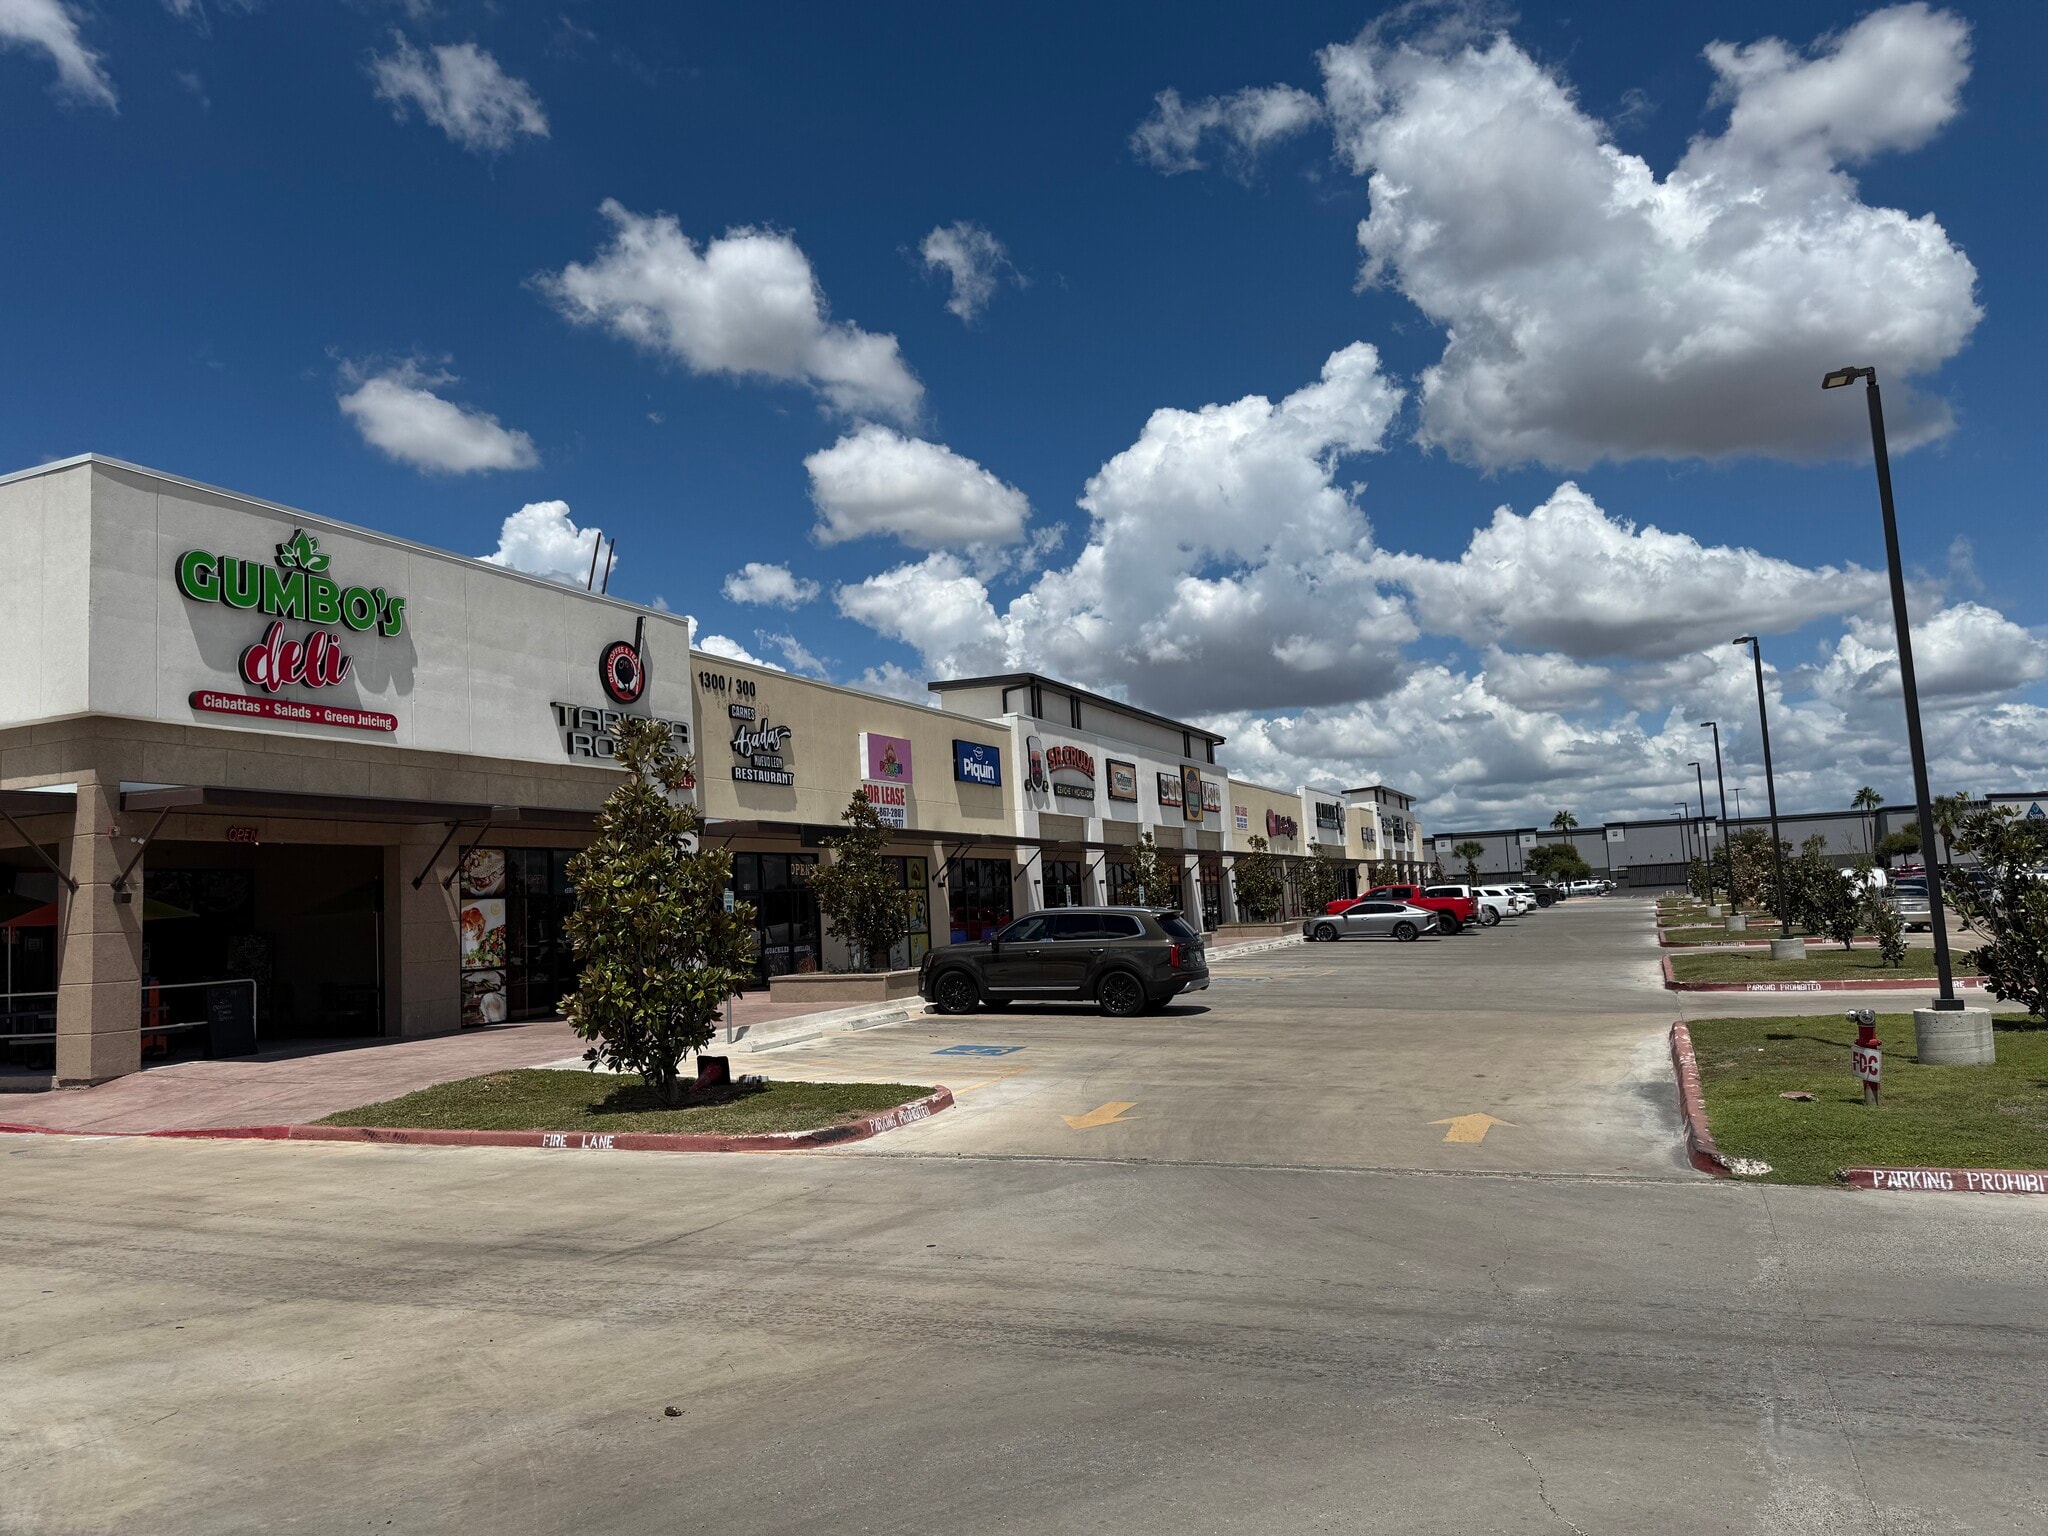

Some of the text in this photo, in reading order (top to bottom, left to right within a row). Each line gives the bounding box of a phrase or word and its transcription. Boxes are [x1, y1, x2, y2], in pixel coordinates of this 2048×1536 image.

[177, 549, 406, 637] GUMBO'S
[241, 620, 352, 692] deli
[699, 671, 726, 691] 1300
[736, 678, 756, 697] 300
[203, 694, 392, 730] Ciabattas Salads Green Juicing
[731, 705, 755, 720] CARNES
[732, 718, 791, 757] Asadas
[735, 767, 794, 785] RESTAURANT
[963, 757, 995, 782] Piquín
[863, 784, 905, 806] FOR LEASE
[228, 828, 258, 842] OPEN
[1746, 983, 1822, 991] PARKING PROHIBITED
[1853, 1051, 1878, 1076] FDC
[868, 1105, 931, 1133] PARKING PROHIBITED
[542, 1134, 615, 1149] FIRE LANE
[1873, 1169, 1953, 1190] PARKING
